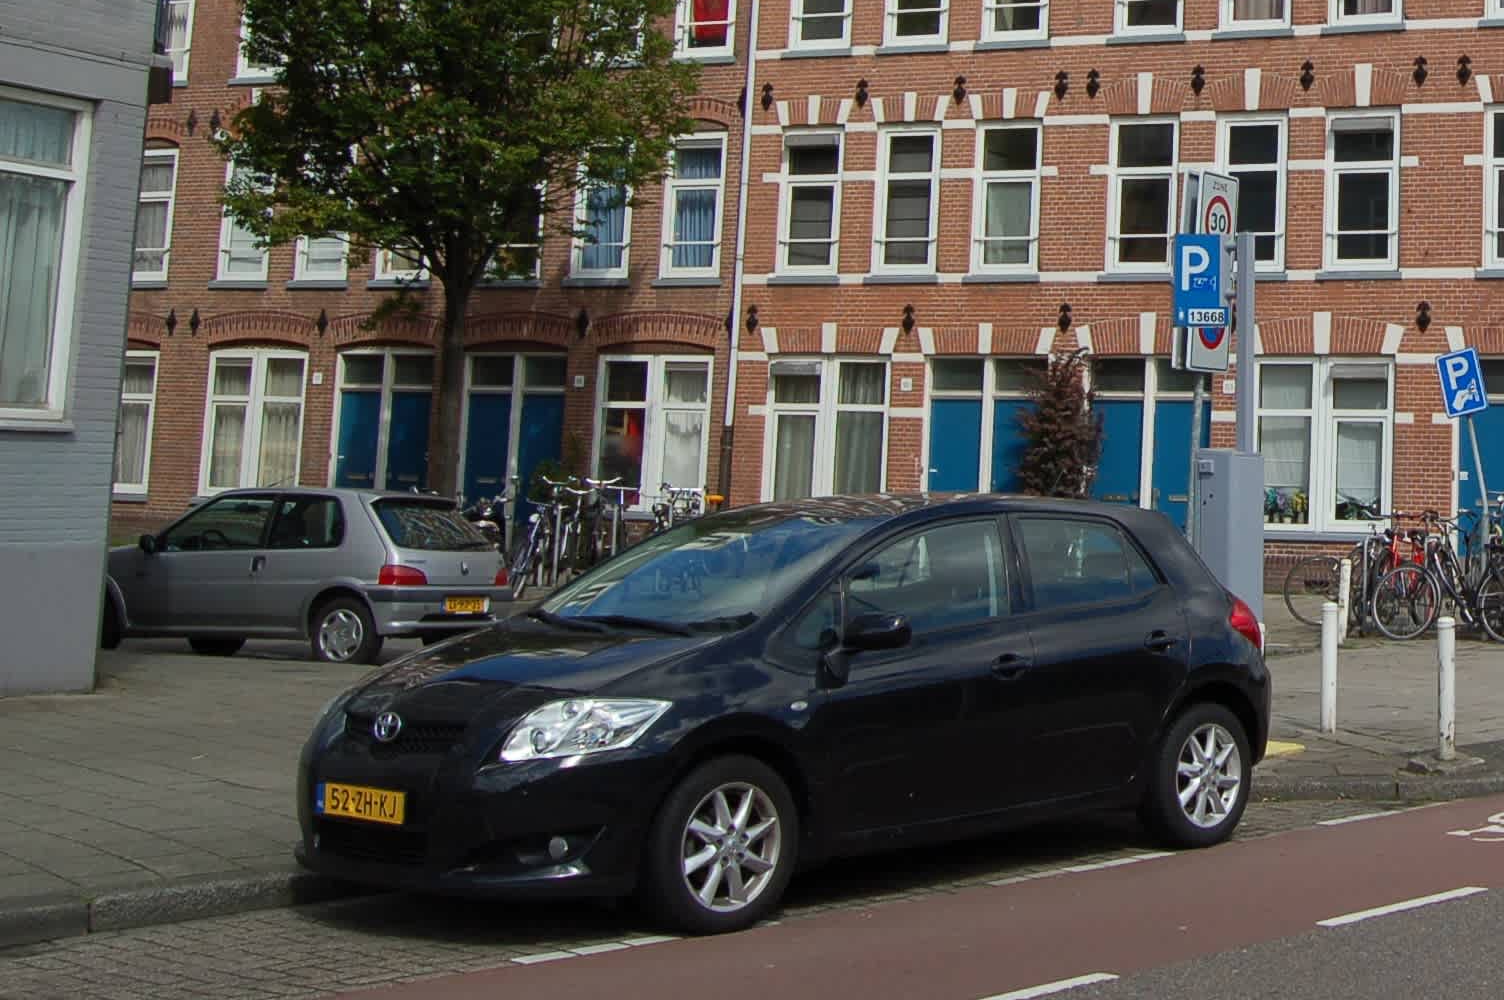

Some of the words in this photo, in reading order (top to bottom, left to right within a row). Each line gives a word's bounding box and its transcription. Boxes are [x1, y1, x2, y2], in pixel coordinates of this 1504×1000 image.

[1210, 212, 1226, 232] 30
[1181, 245, 1210, 291] P
[1190, 311, 1225, 322] 13668
[1446, 357, 1470, 390] P
[330, 787, 398, 819] 52-ZH-KJ
